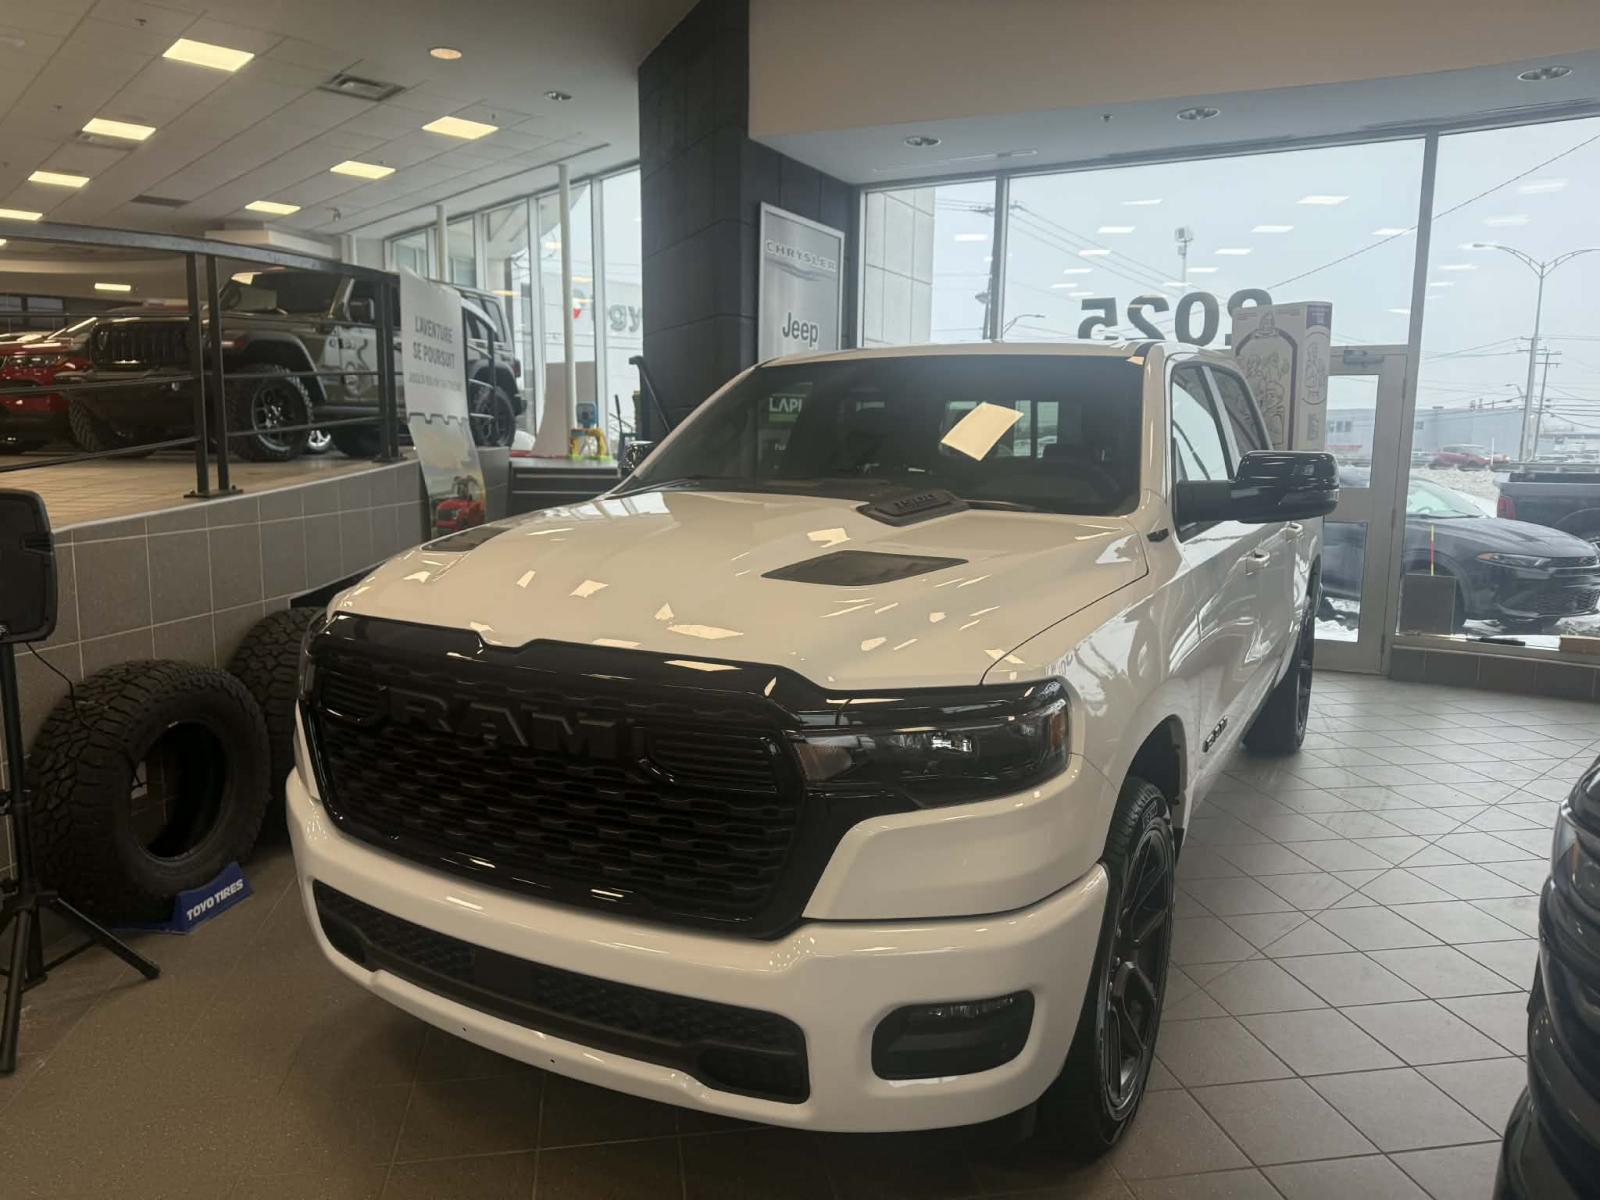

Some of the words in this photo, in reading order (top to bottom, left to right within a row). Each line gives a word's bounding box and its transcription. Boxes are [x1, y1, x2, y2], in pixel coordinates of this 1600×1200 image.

[766, 242, 837, 272] CHRYSLER
[782, 312, 819, 347] Jeep
[388, 684, 622, 757] RAM
[187, 897, 215, 921] TOYO
[214, 878, 244, 904] TIRES
